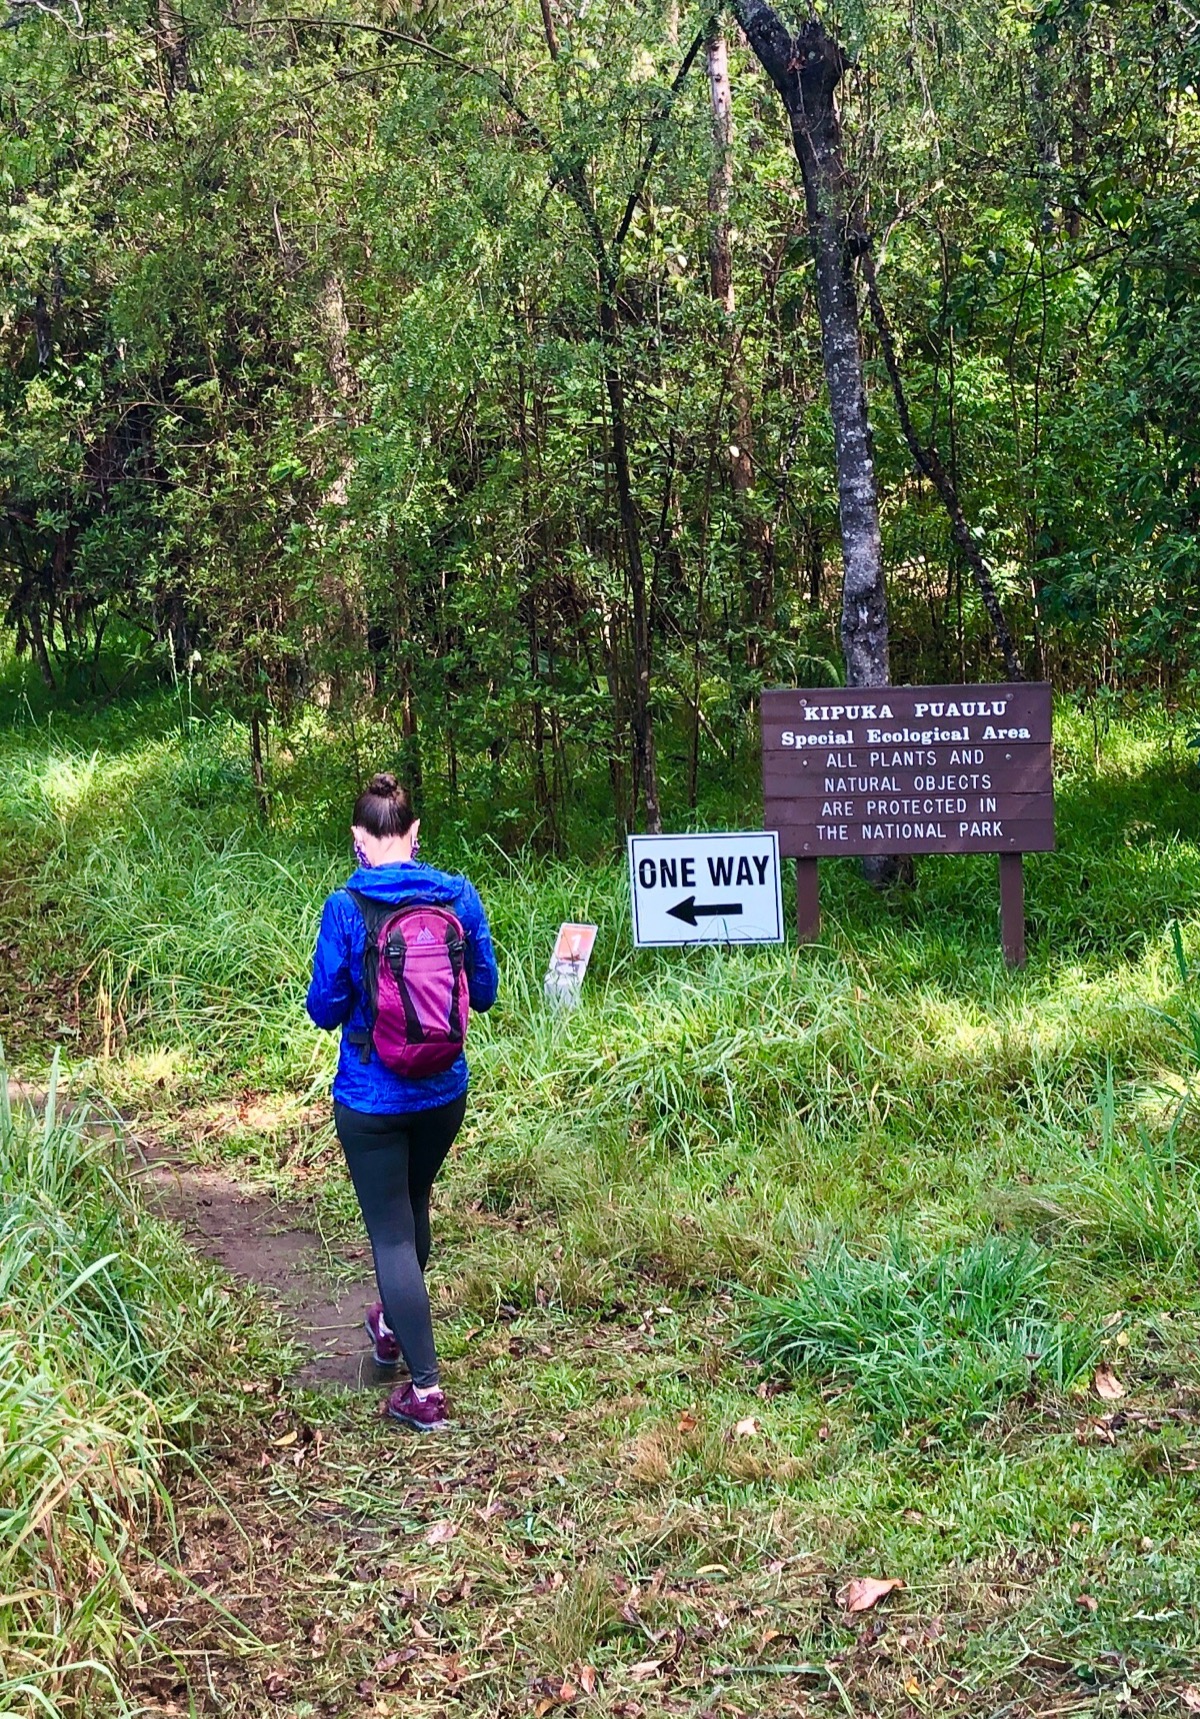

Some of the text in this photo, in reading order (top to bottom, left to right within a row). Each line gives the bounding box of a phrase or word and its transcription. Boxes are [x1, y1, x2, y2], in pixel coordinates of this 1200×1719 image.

[803, 701, 1007, 721] KIPUKA PUAULU
[781, 726, 1031, 749] Special Ecological Area
[826, 749, 985, 768] ALL PLANTS AND
[824, 774, 992, 792] NATURAL OBJECTS
[821, 798, 997, 816] ARE PROTECTED IN
[816, 821, 1003, 840] THE NATIONAL PARK
[638, 855, 769, 889] ONE WAY
[571, 934, 582, 953] 1
